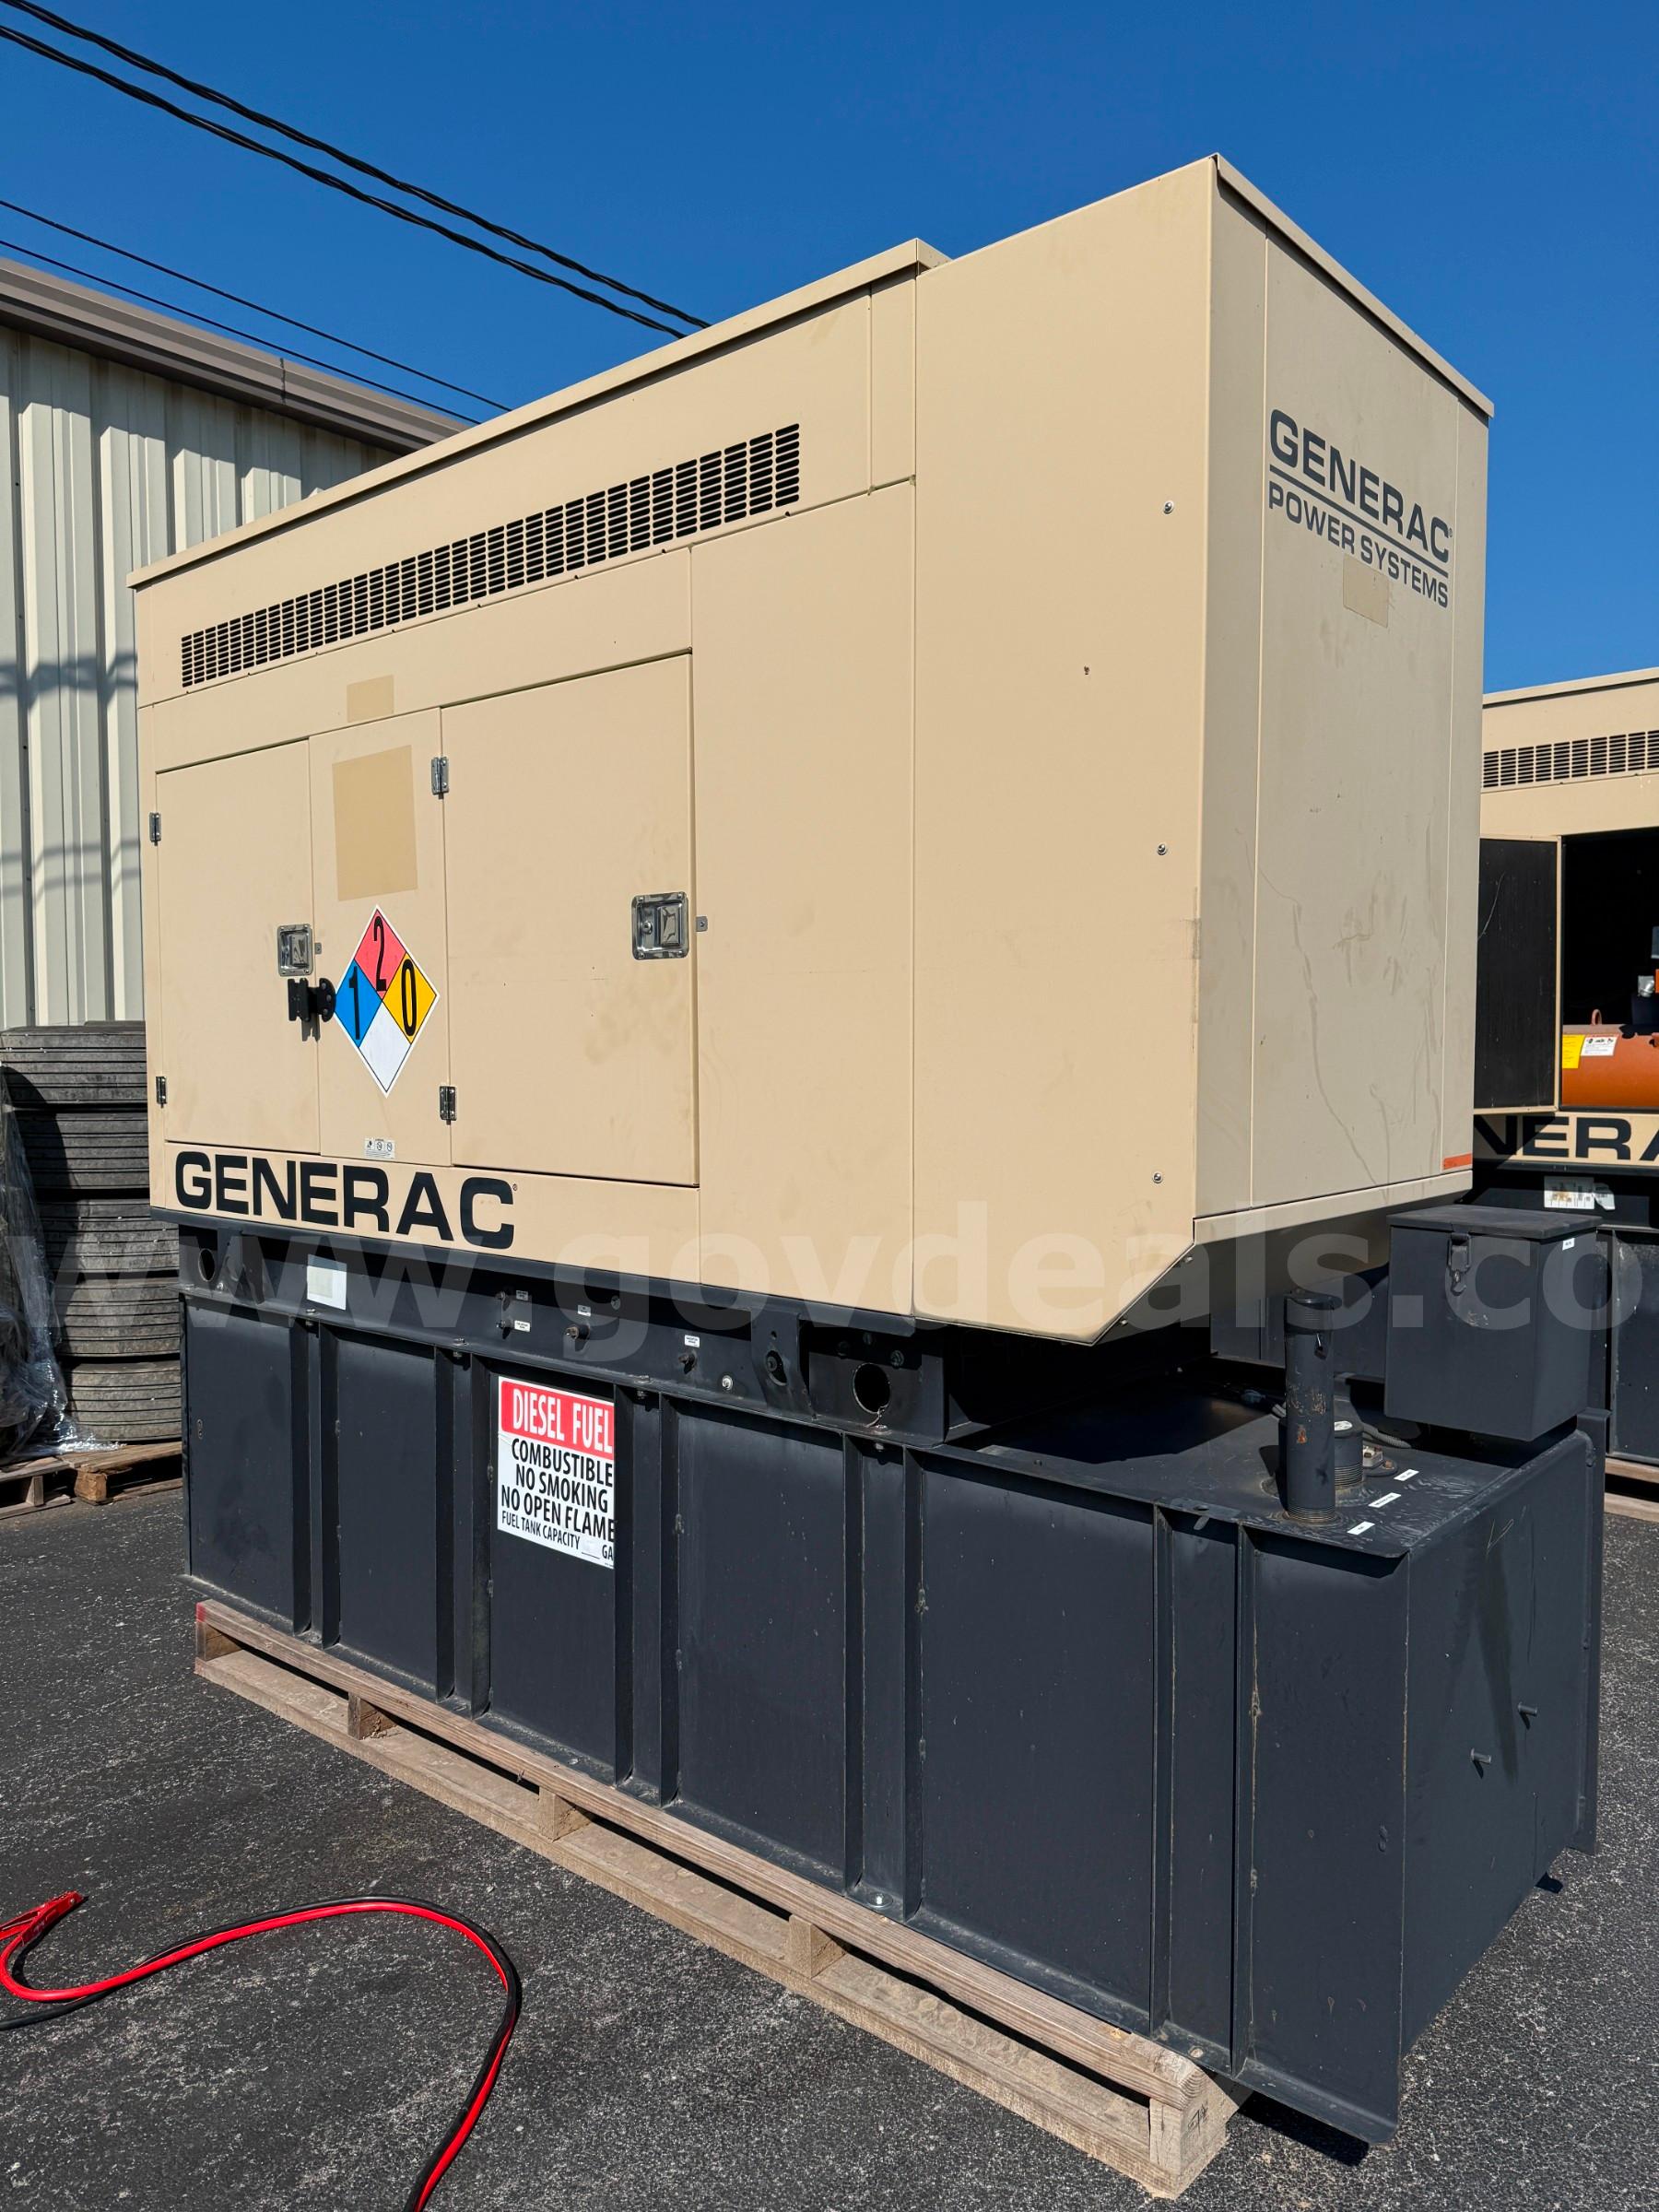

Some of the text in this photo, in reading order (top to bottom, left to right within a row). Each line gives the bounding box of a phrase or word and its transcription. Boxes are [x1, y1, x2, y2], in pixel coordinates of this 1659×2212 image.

[1270, 408, 1450, 564] GENERAC
[1268, 480, 1449, 608] POWER SYSTEMS
[373, 915, 387, 992] 2
[348, 965, 360, 1041] 1
[174, 1150, 515, 1250] GENERAC
[512, 1388, 613, 1454] DIESEL FUEL
[512, 1438, 613, 1488] COMBUSTIBLE
[515, 1464, 608, 1513] NO SMOKING
[501, 1485, 615, 1543] NO OPEN FLAME
[501, 1511, 520, 1529] FUEL
[521, 1516, 541, 1537] TANK
[543, 1524, 580, 1550] CAPACITY
